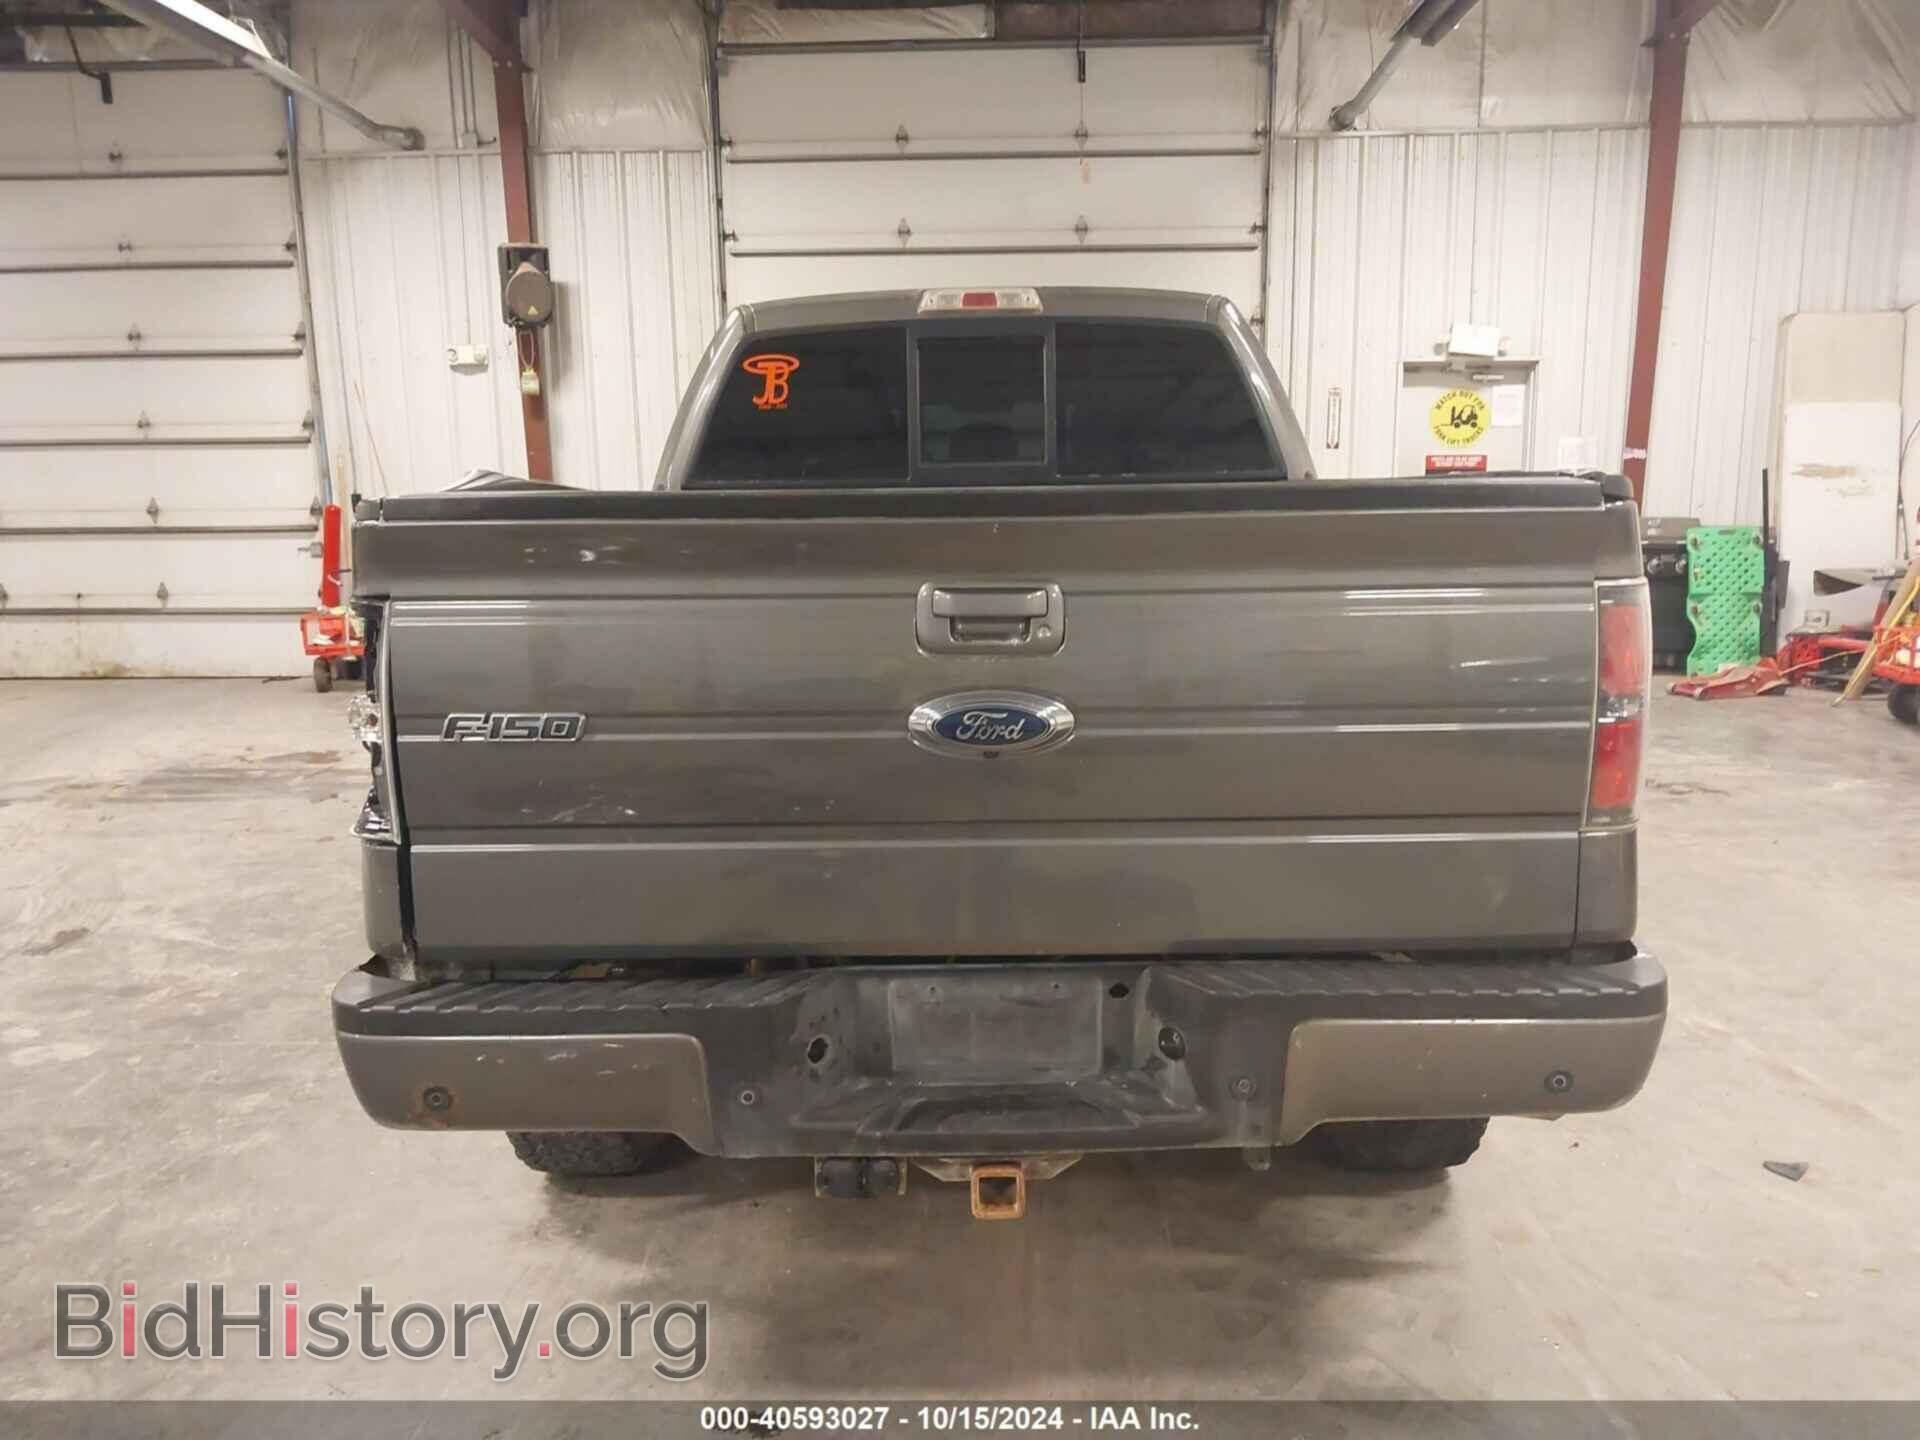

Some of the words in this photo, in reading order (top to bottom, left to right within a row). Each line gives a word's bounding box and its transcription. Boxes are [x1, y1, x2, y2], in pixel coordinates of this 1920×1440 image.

[1434, 391, 1457, 410] WATCH
[1459, 390, 1473, 399] OUT
[440, 712, 587, 742] F-150
[956, 711, 1026, 740] Ford
